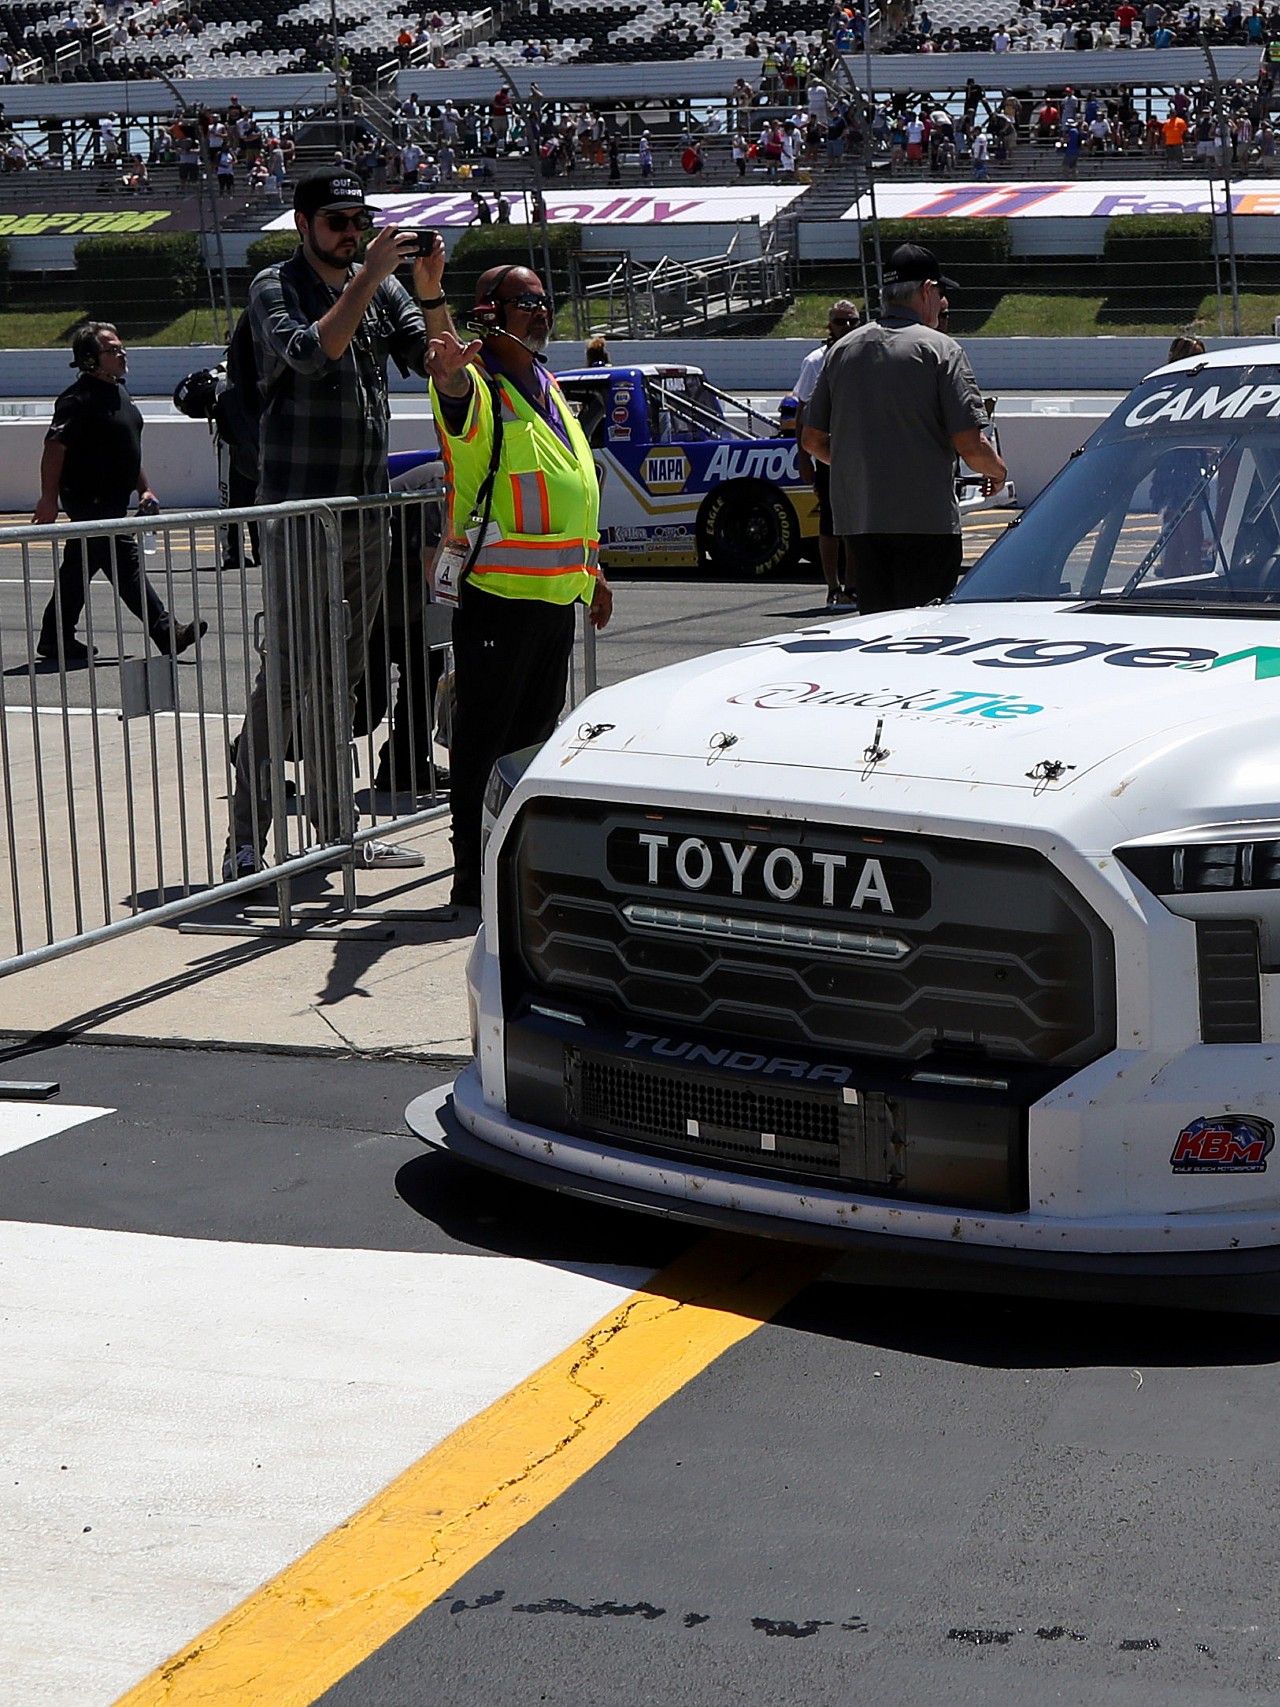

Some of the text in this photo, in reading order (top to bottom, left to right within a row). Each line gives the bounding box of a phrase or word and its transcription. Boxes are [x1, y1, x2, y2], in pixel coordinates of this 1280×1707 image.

[545, 196, 706, 224] ally
[903, 185, 1078, 218] 11
[648, 458, 685, 482] NAPA
[706, 496, 724, 536] EAGLE
[754, 503, 790, 575] GOODYEAR
[638, 833, 895, 914] TOYOTA
[623, 1030, 853, 1085] TUNDRA
[1173, 1128, 1266, 1164] KBM
